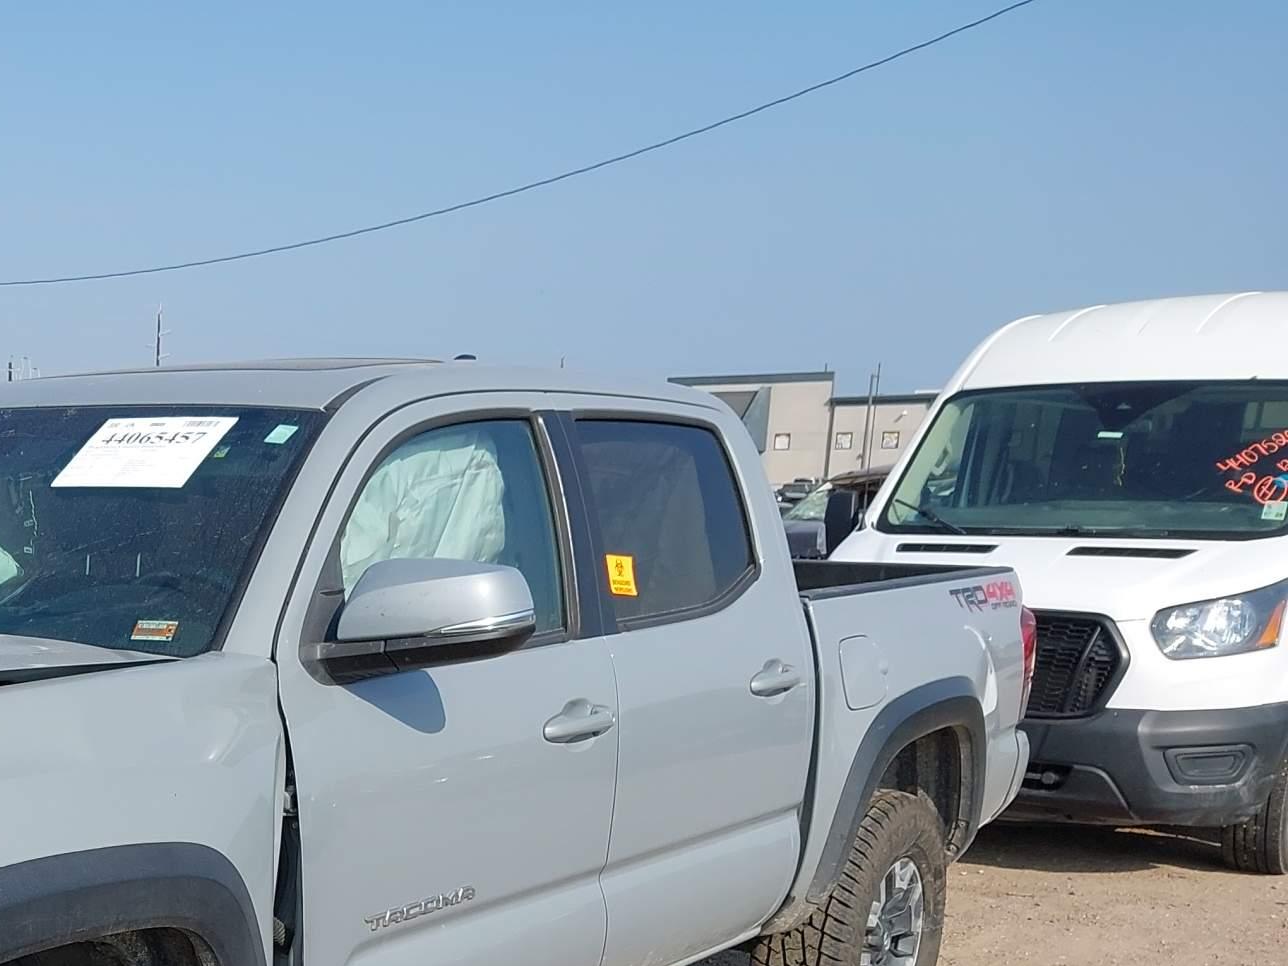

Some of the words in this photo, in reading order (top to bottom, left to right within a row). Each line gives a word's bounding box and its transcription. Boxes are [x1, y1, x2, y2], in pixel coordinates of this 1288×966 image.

[101, 431, 208, 445] 44065457
[949, 585, 988, 612] TRD
[364, 885, 476, 931] TACOMA
